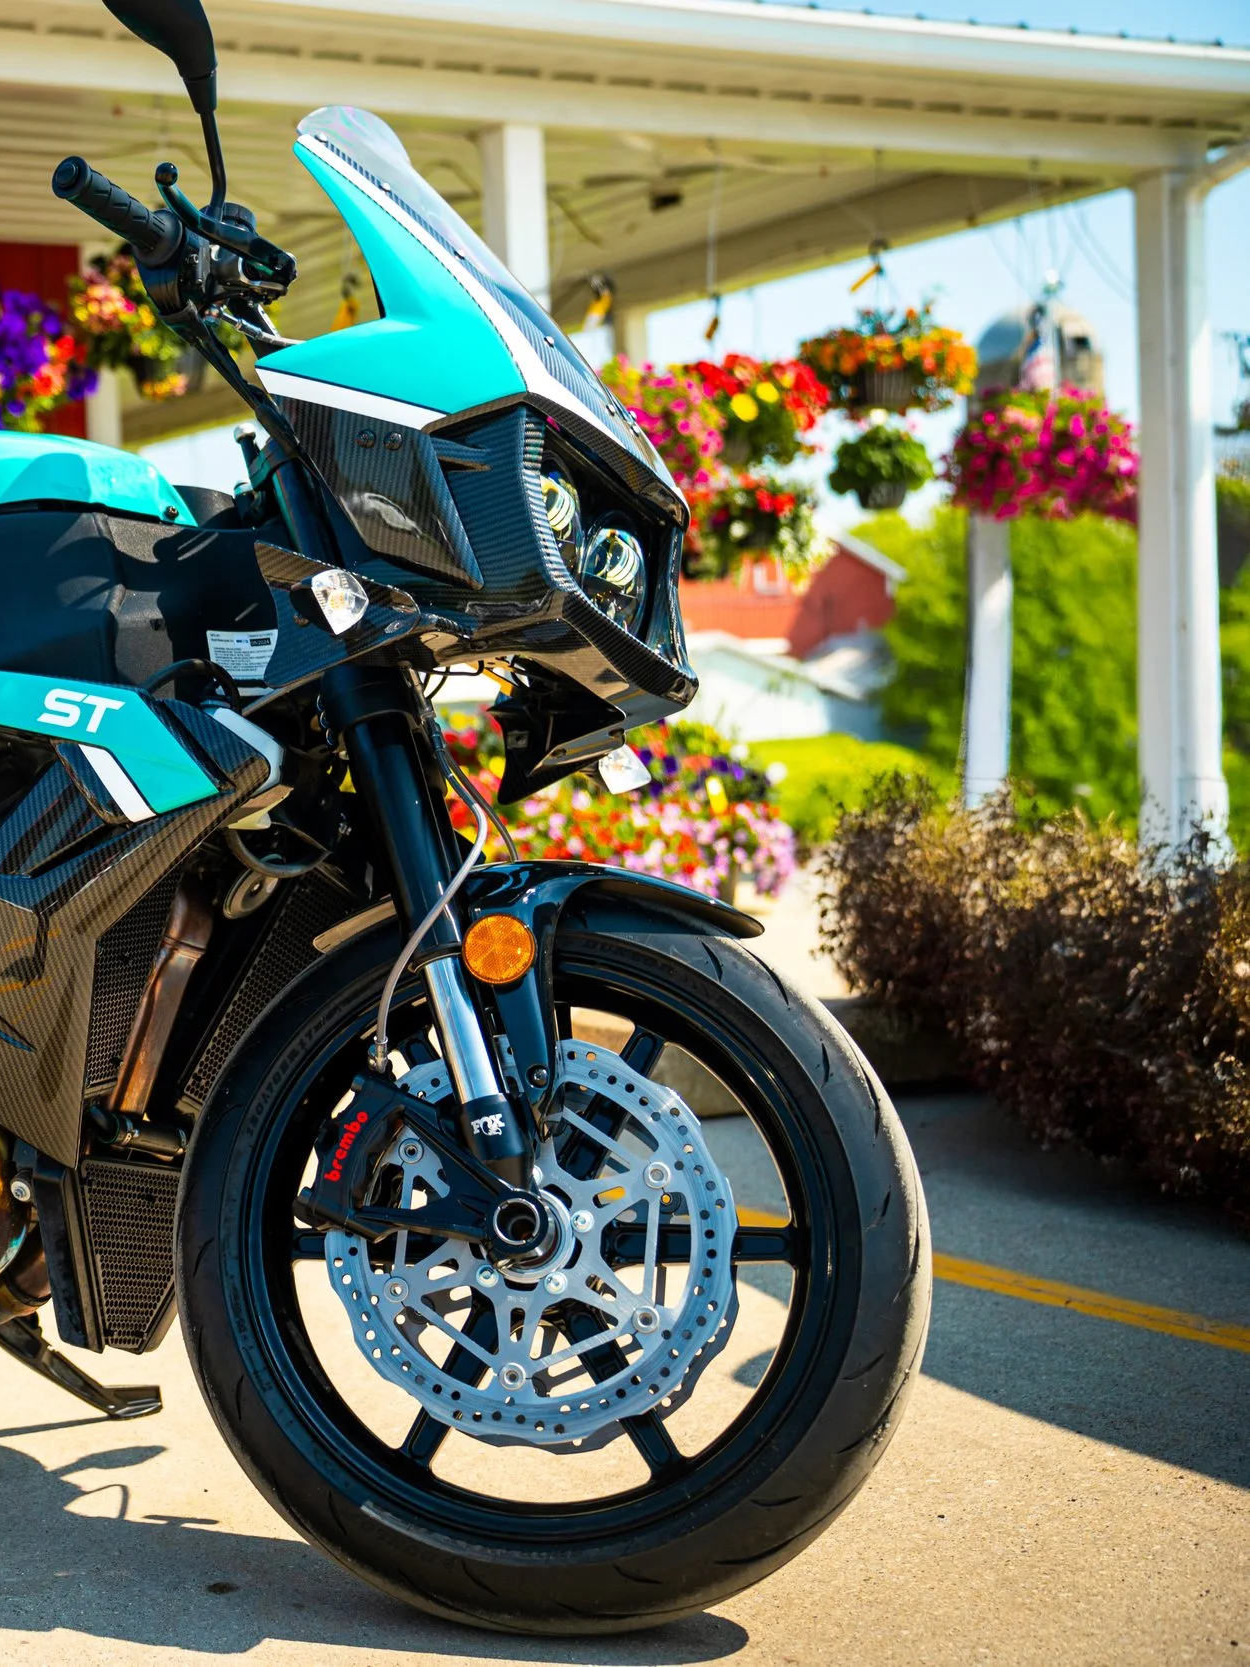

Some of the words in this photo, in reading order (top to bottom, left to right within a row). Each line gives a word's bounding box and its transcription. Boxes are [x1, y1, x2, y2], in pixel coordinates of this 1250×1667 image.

[36, 688, 126, 734] ST
[324, 1111, 369, 1182] brembo
[470, 1113, 506, 1136] FOX
